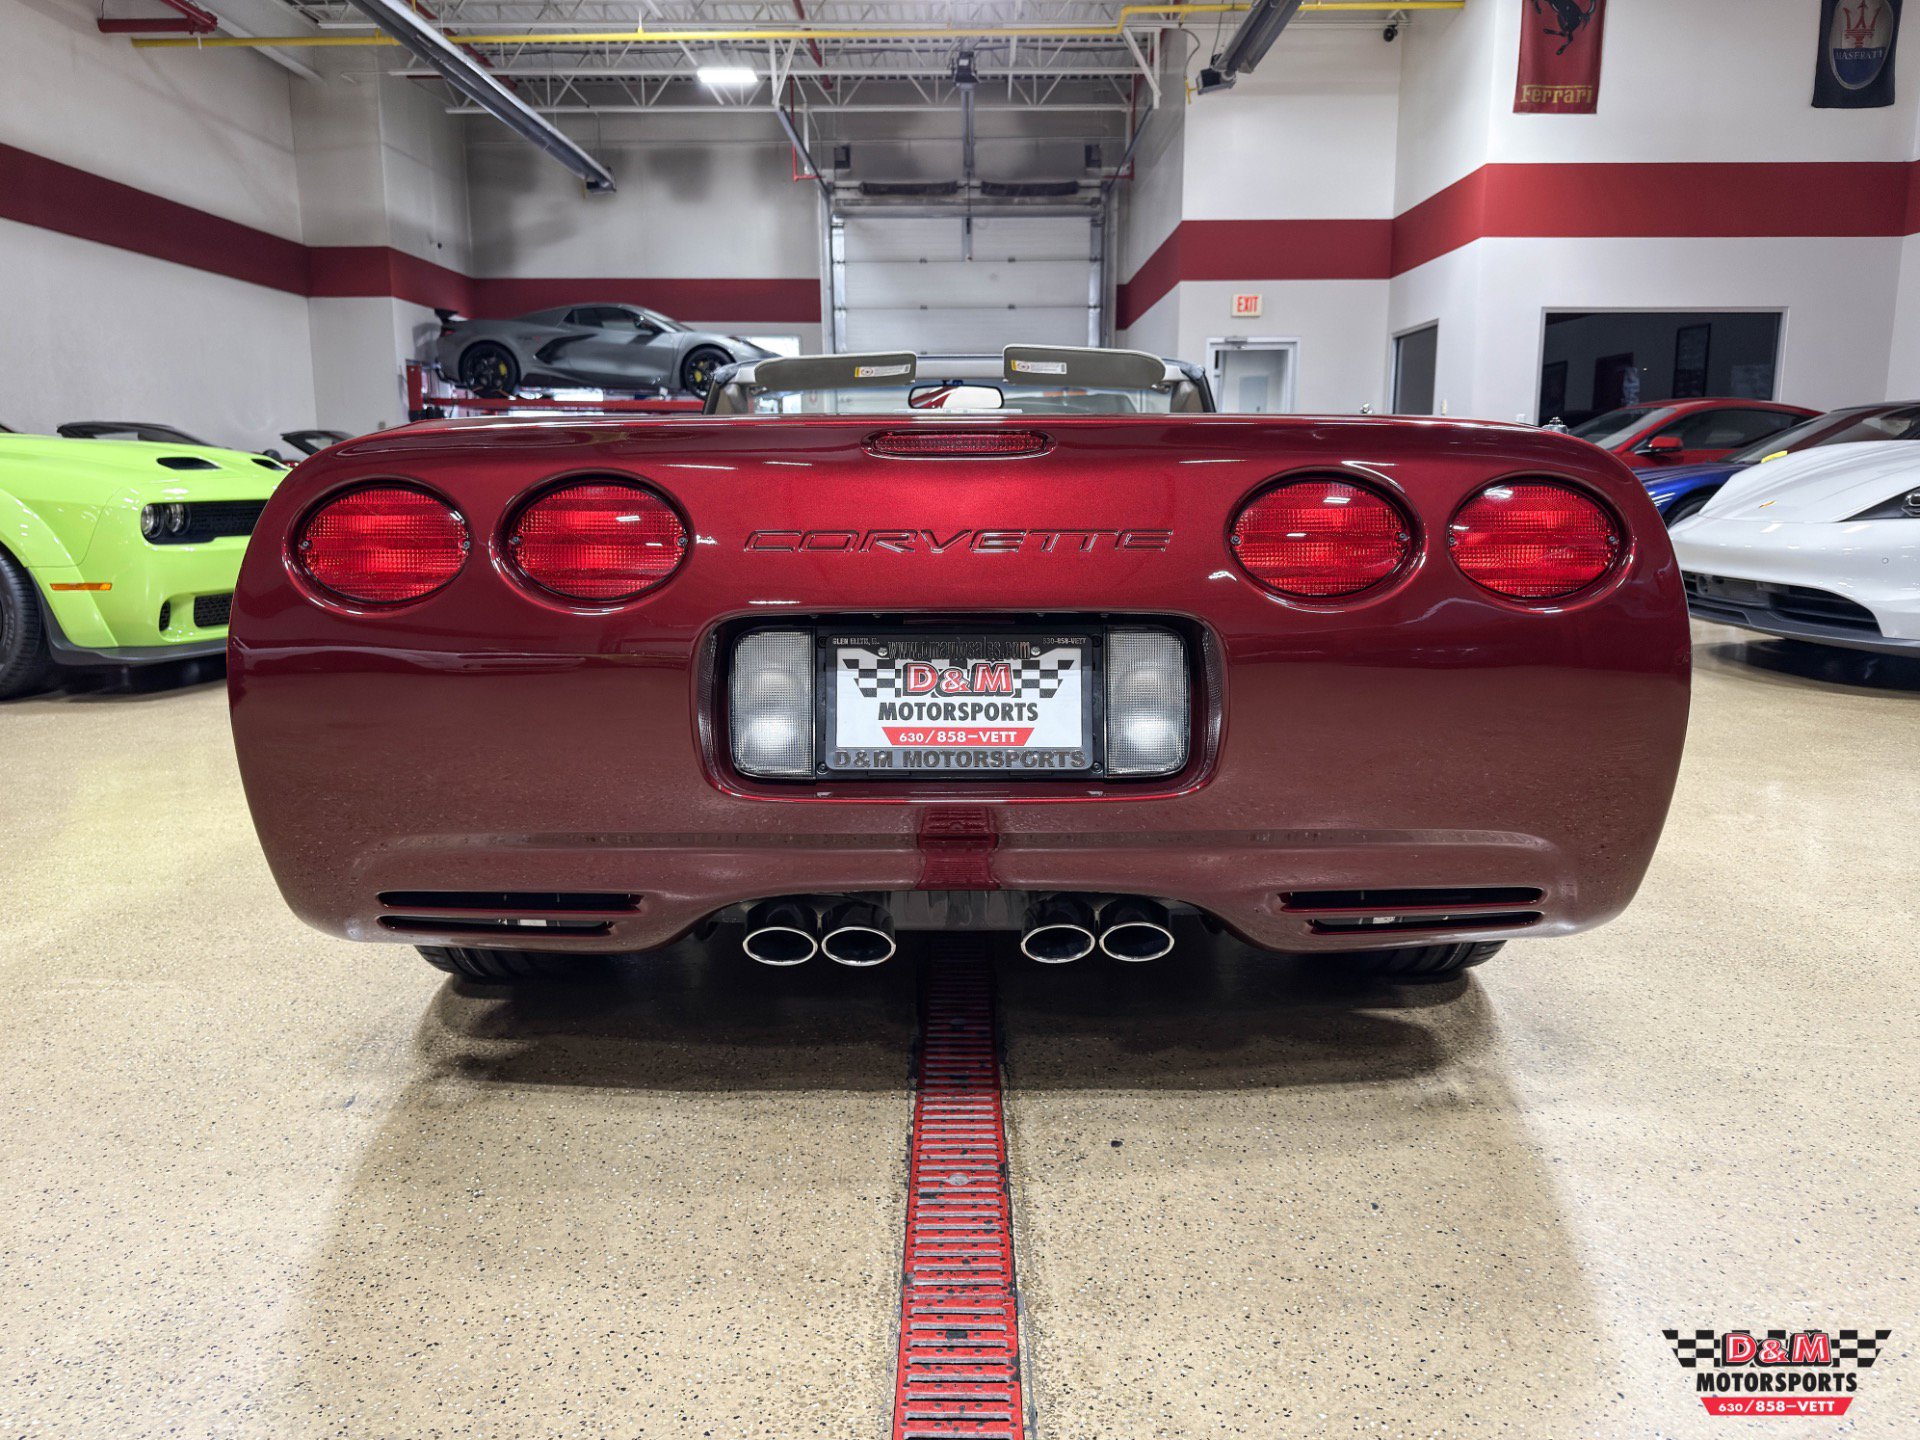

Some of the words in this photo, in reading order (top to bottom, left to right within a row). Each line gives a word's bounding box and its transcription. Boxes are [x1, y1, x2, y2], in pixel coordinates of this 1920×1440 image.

[1835, 49, 1883, 60] MASERATI
[1520, 84, 1593, 104] Ferrari
[1237, 295, 1258, 313] EXIT
[743, 528, 1175, 554] CORVETTE
[904, 662, 1015, 695] D&M
[877, 701, 1039, 722] MOTORSPORTS
[834, 750, 893, 768] D&M
[902, 750, 1086, 768] MOTORSPORTS
